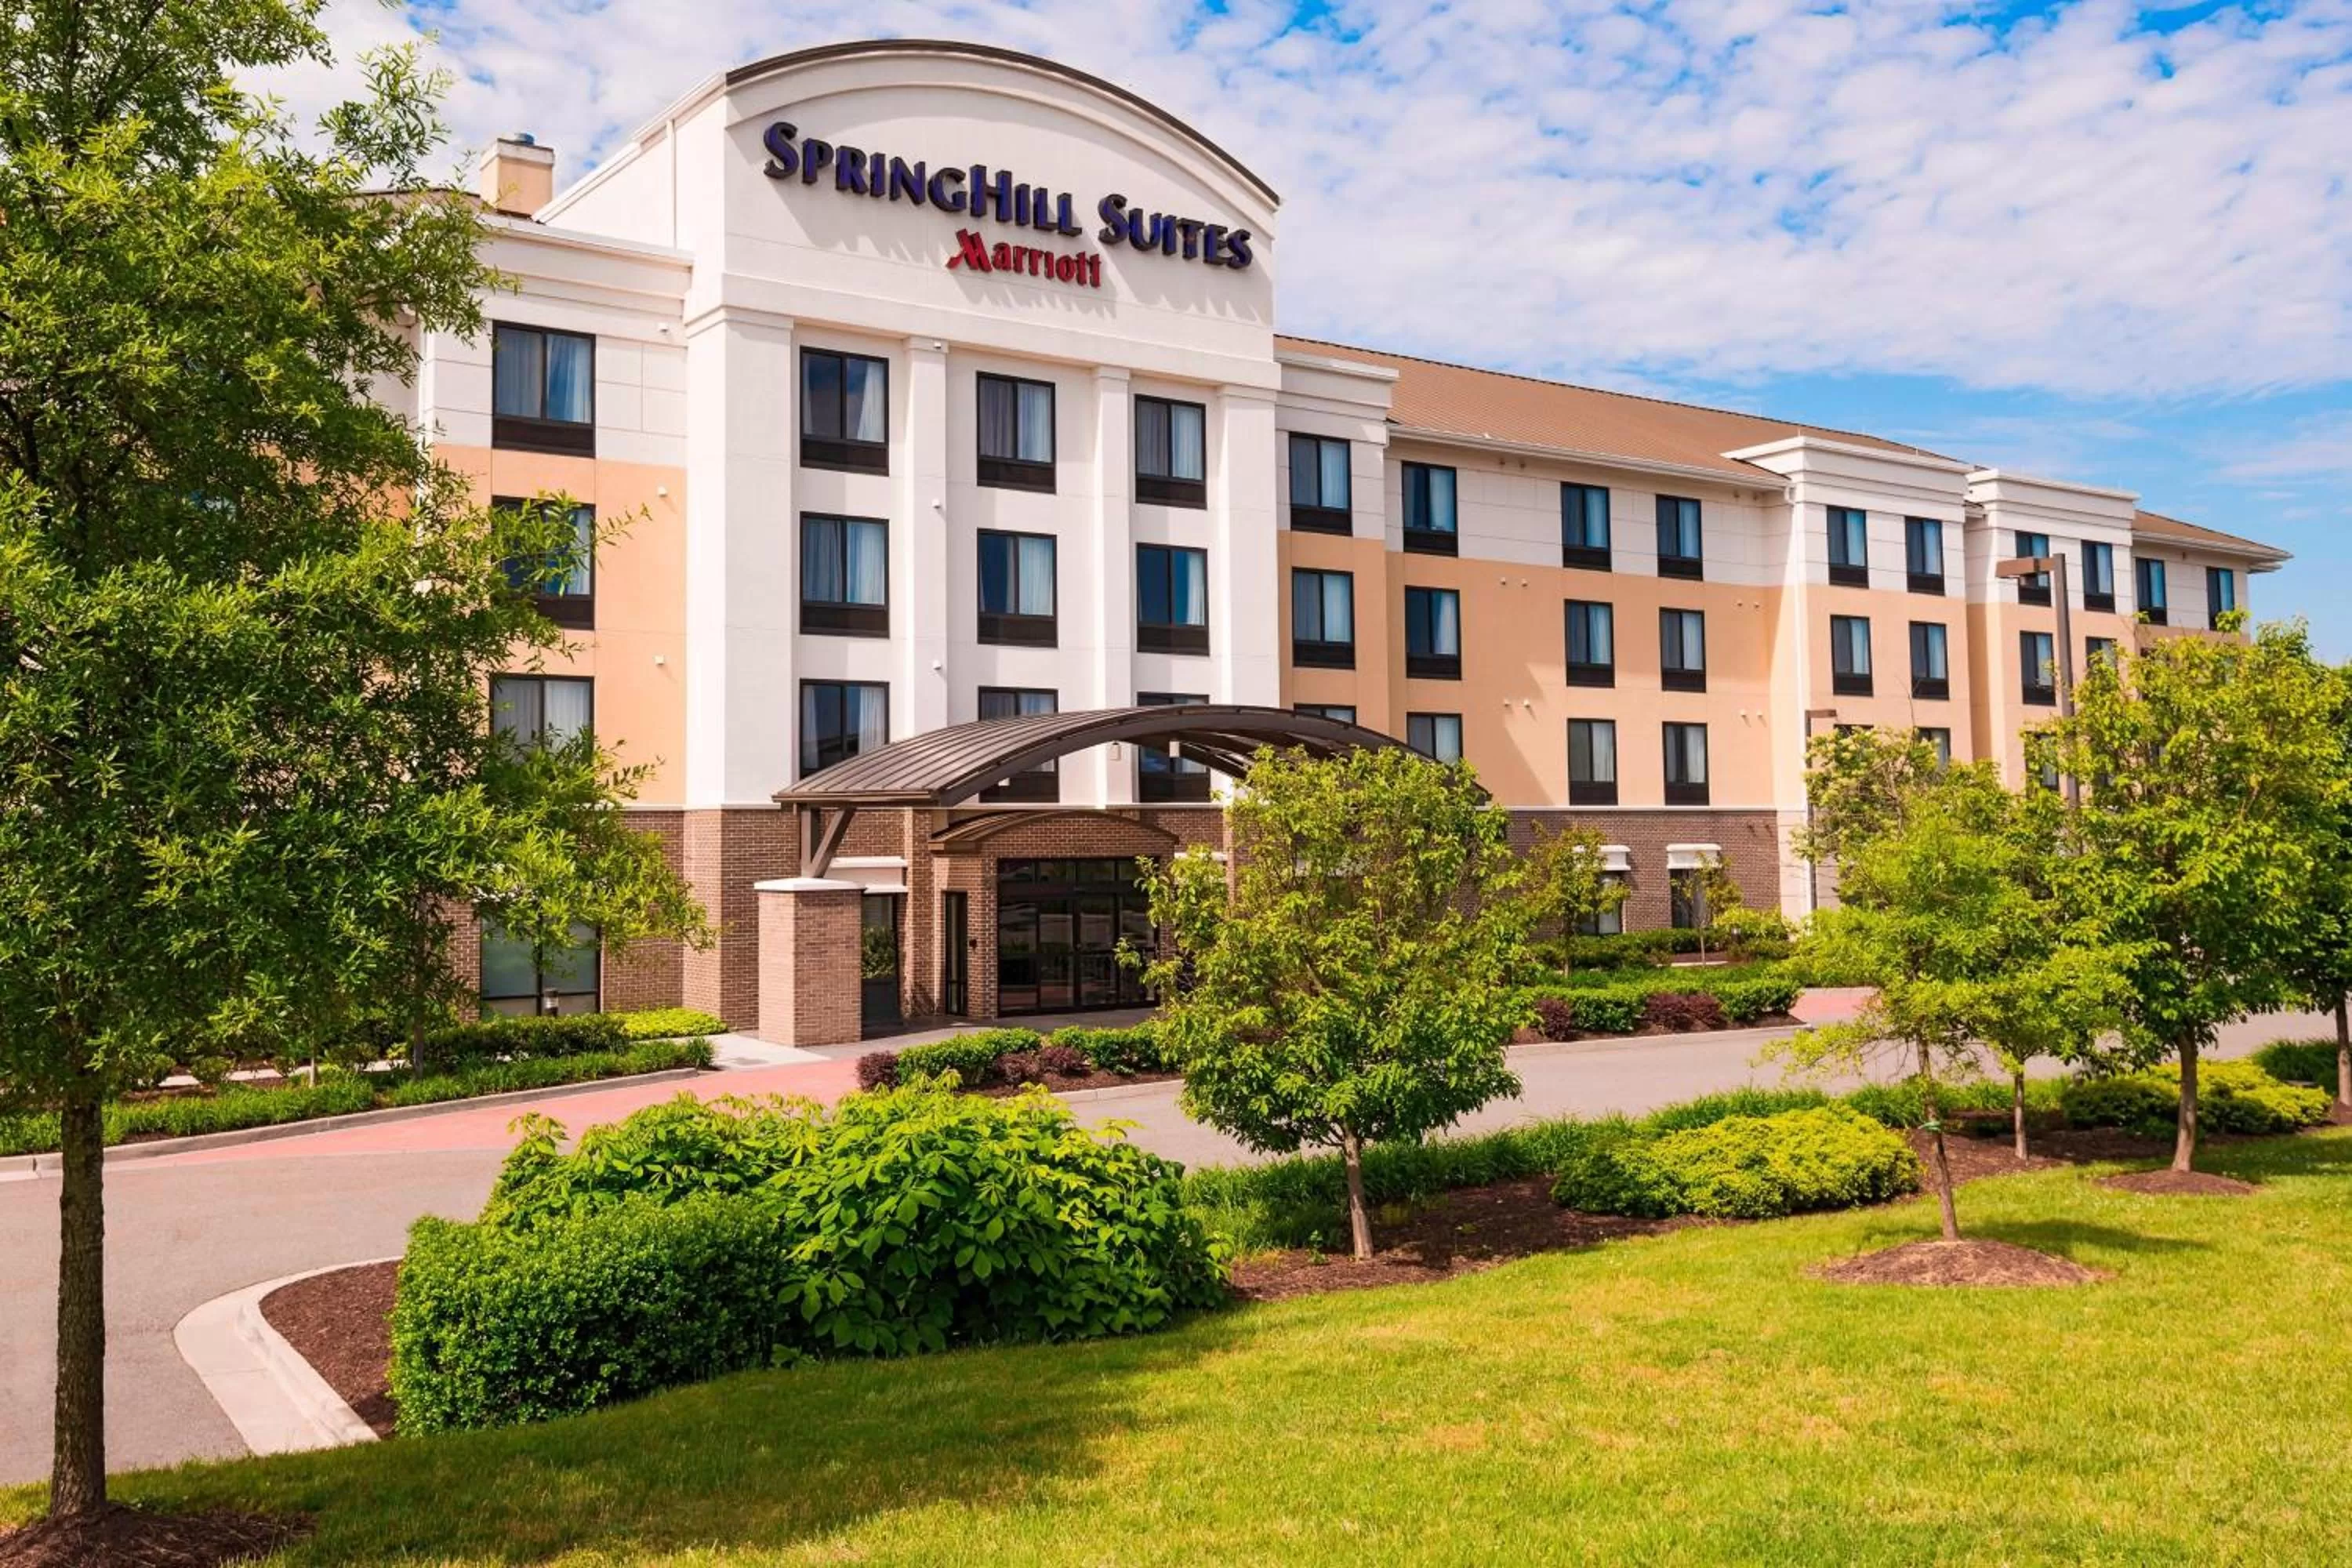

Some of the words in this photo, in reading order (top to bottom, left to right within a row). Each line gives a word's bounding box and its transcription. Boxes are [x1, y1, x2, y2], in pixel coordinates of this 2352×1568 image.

[764, 122, 1082, 236] SPRINGHILL
[1098, 193, 1253, 270] SUITES
[946, 228, 1102, 288] Marriott
